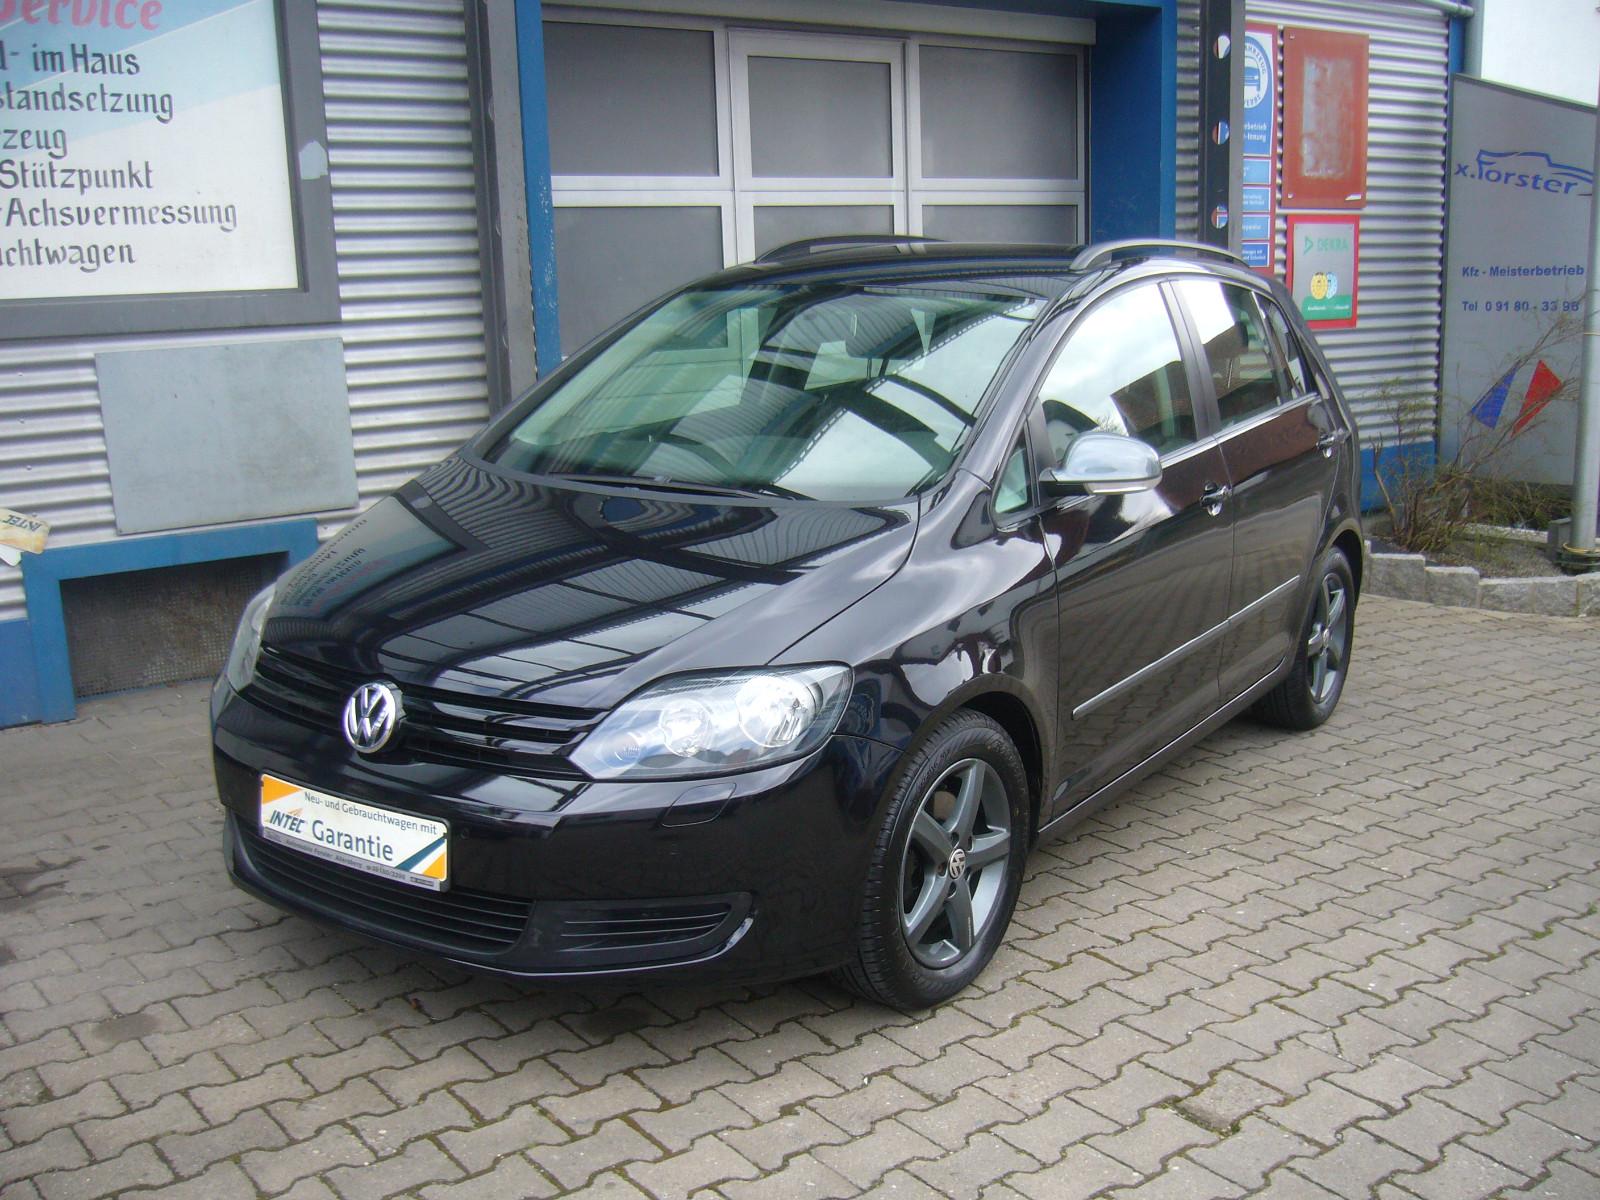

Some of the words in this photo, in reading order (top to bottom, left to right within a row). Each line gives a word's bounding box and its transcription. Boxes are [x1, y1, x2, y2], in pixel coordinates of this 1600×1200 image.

[32, 43, 66, 73] im
[70, 43, 140, 75] Haus
[0, 128, 68, 159] zeug
[0, 159, 153, 195] Stützpunkt
[0, 197, 238, 232] Achsvermessung
[1489, 264, 1585, 276] Meisterbetrieb
[1462, 301, 1478, 312] Tel
[304, 791, 323, 805] Neu-
[325, 799, 340, 811] und
[342, 803, 418, 831] Gebrauchtwagen
[420, 823, 438, 835] mit
[270, 809, 306, 833] INTEC
[312, 819, 394, 861] Garantie
